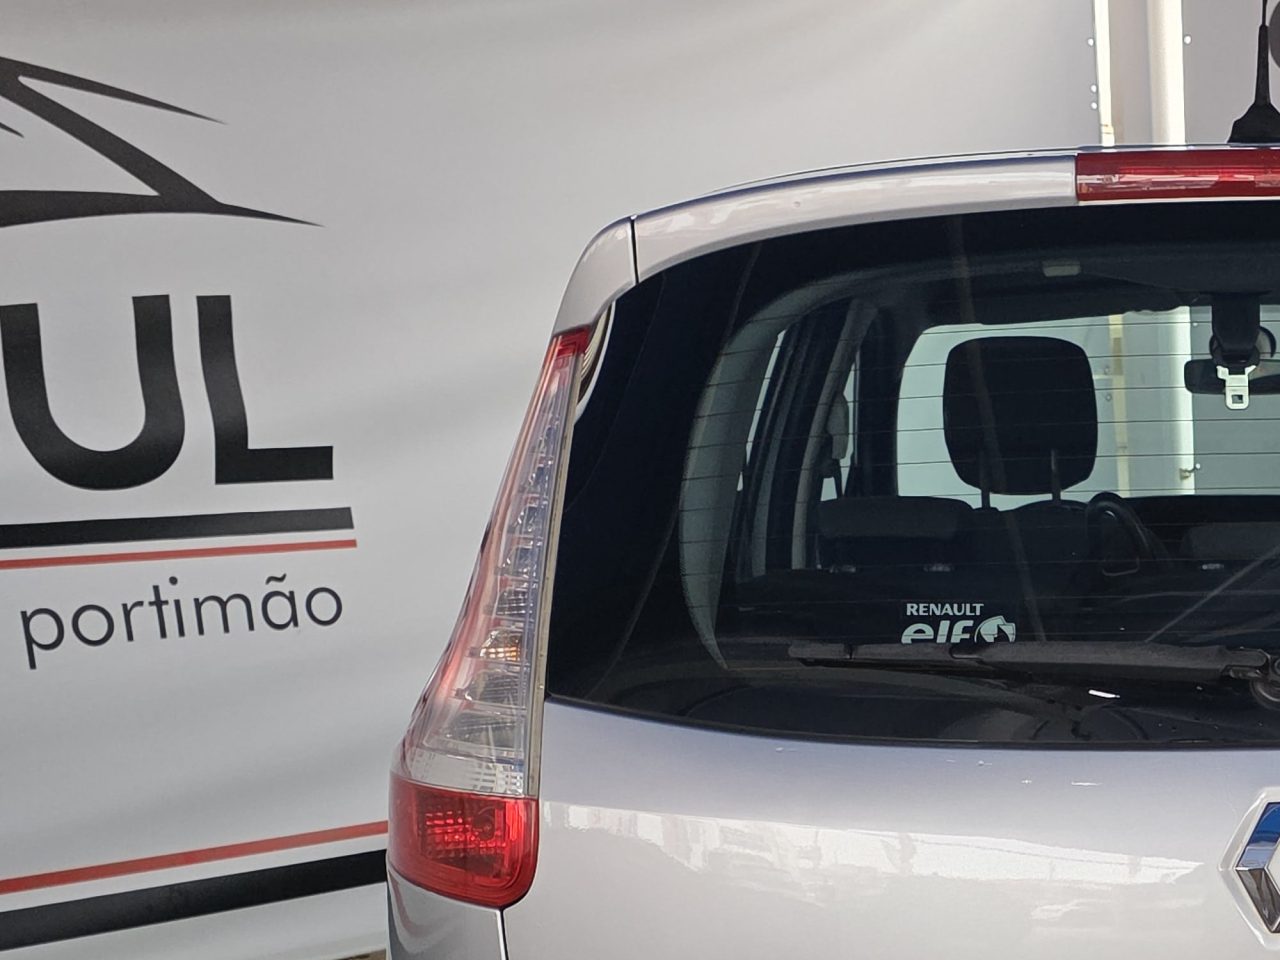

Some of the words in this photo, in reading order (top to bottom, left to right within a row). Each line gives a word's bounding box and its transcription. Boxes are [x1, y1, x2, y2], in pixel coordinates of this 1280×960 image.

[20, 573, 344, 669] portimão
[906, 603, 984, 616] RENAULT
[901, 620, 974, 644] elf
